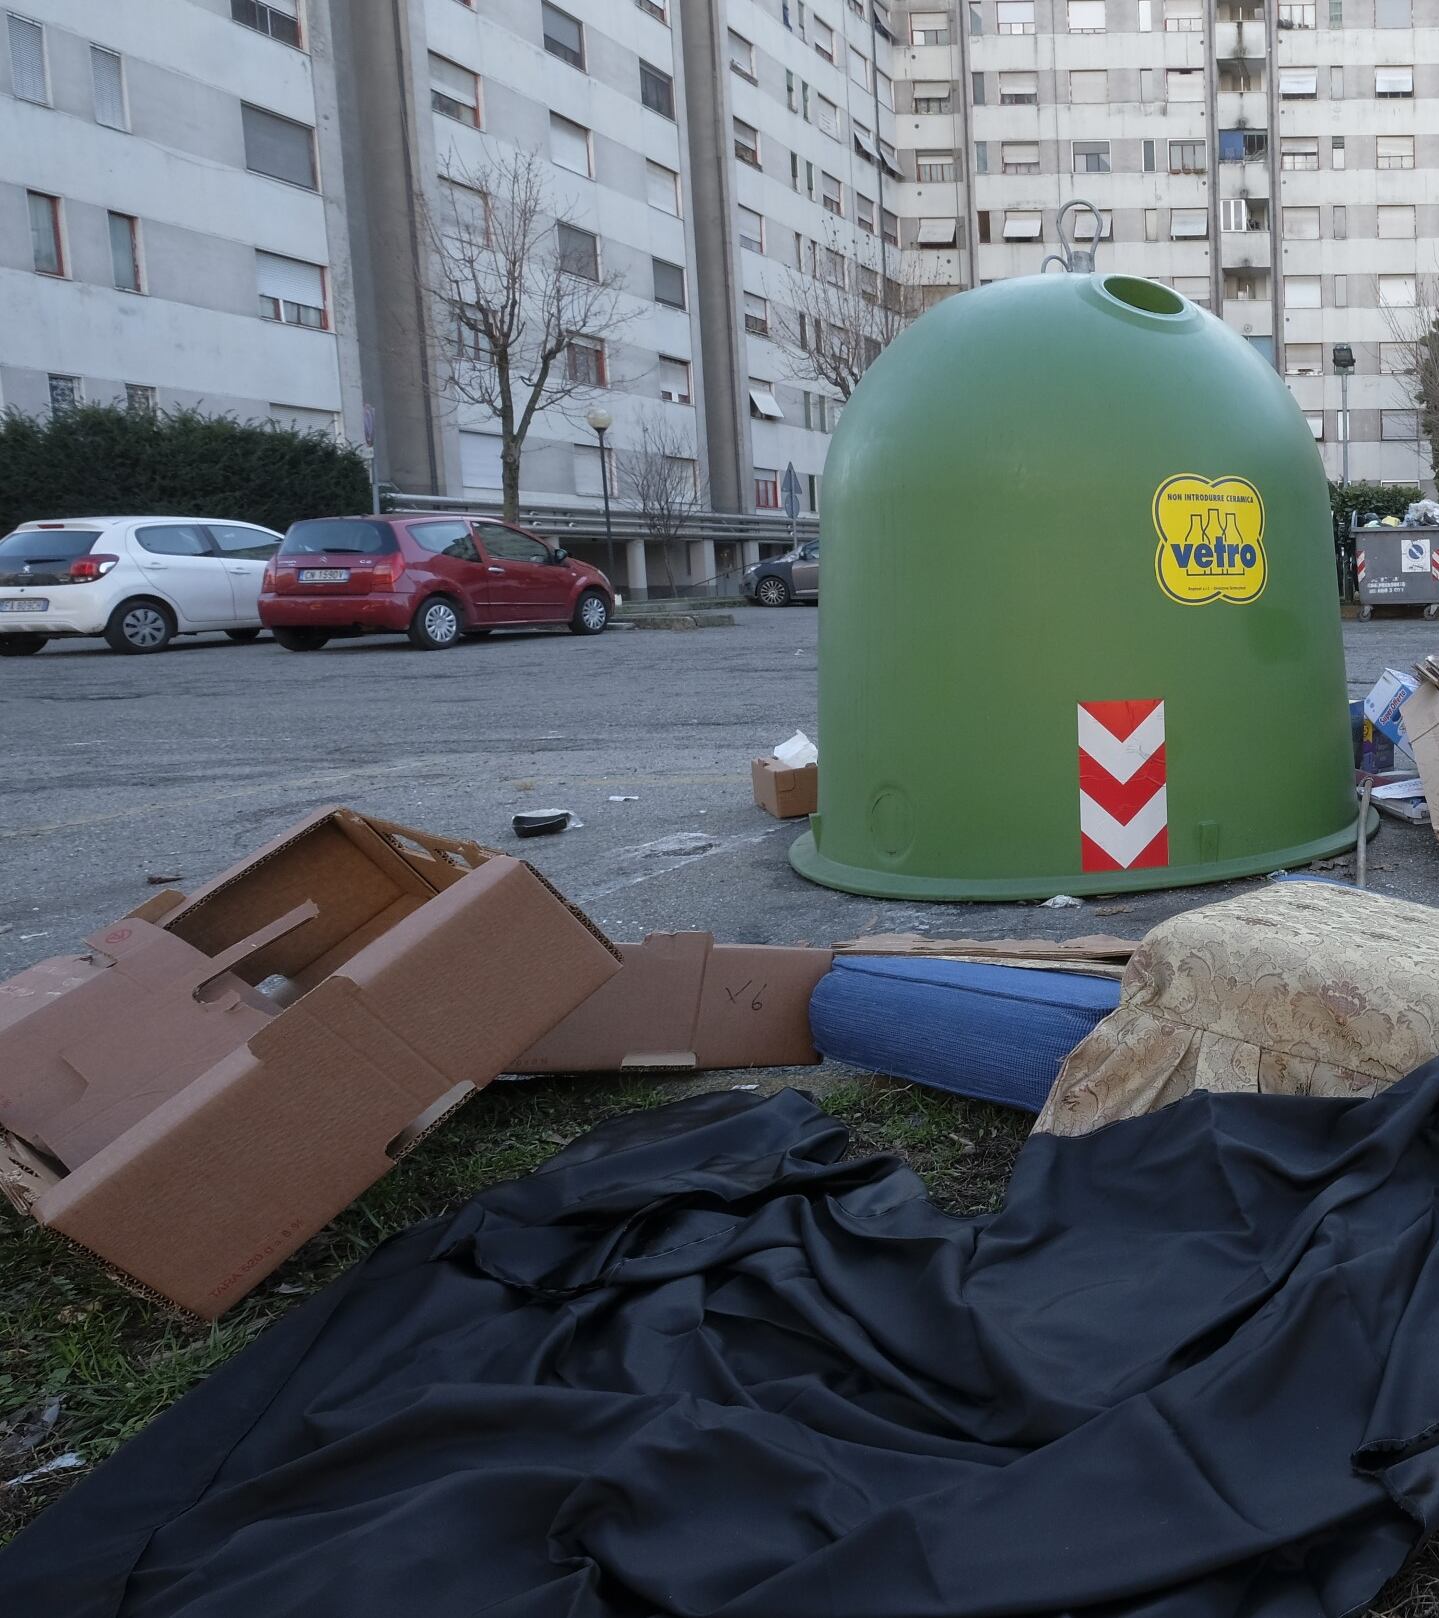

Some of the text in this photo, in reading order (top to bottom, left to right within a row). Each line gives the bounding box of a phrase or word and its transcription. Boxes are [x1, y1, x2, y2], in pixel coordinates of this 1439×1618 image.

[1185, 494, 1224, 502] INTRODURRE
[1226, 495, 1254, 503] CERAMICA
[1171, 536, 1257, 568] vetro
[1379, 689, 1407, 725] Super Offerta
